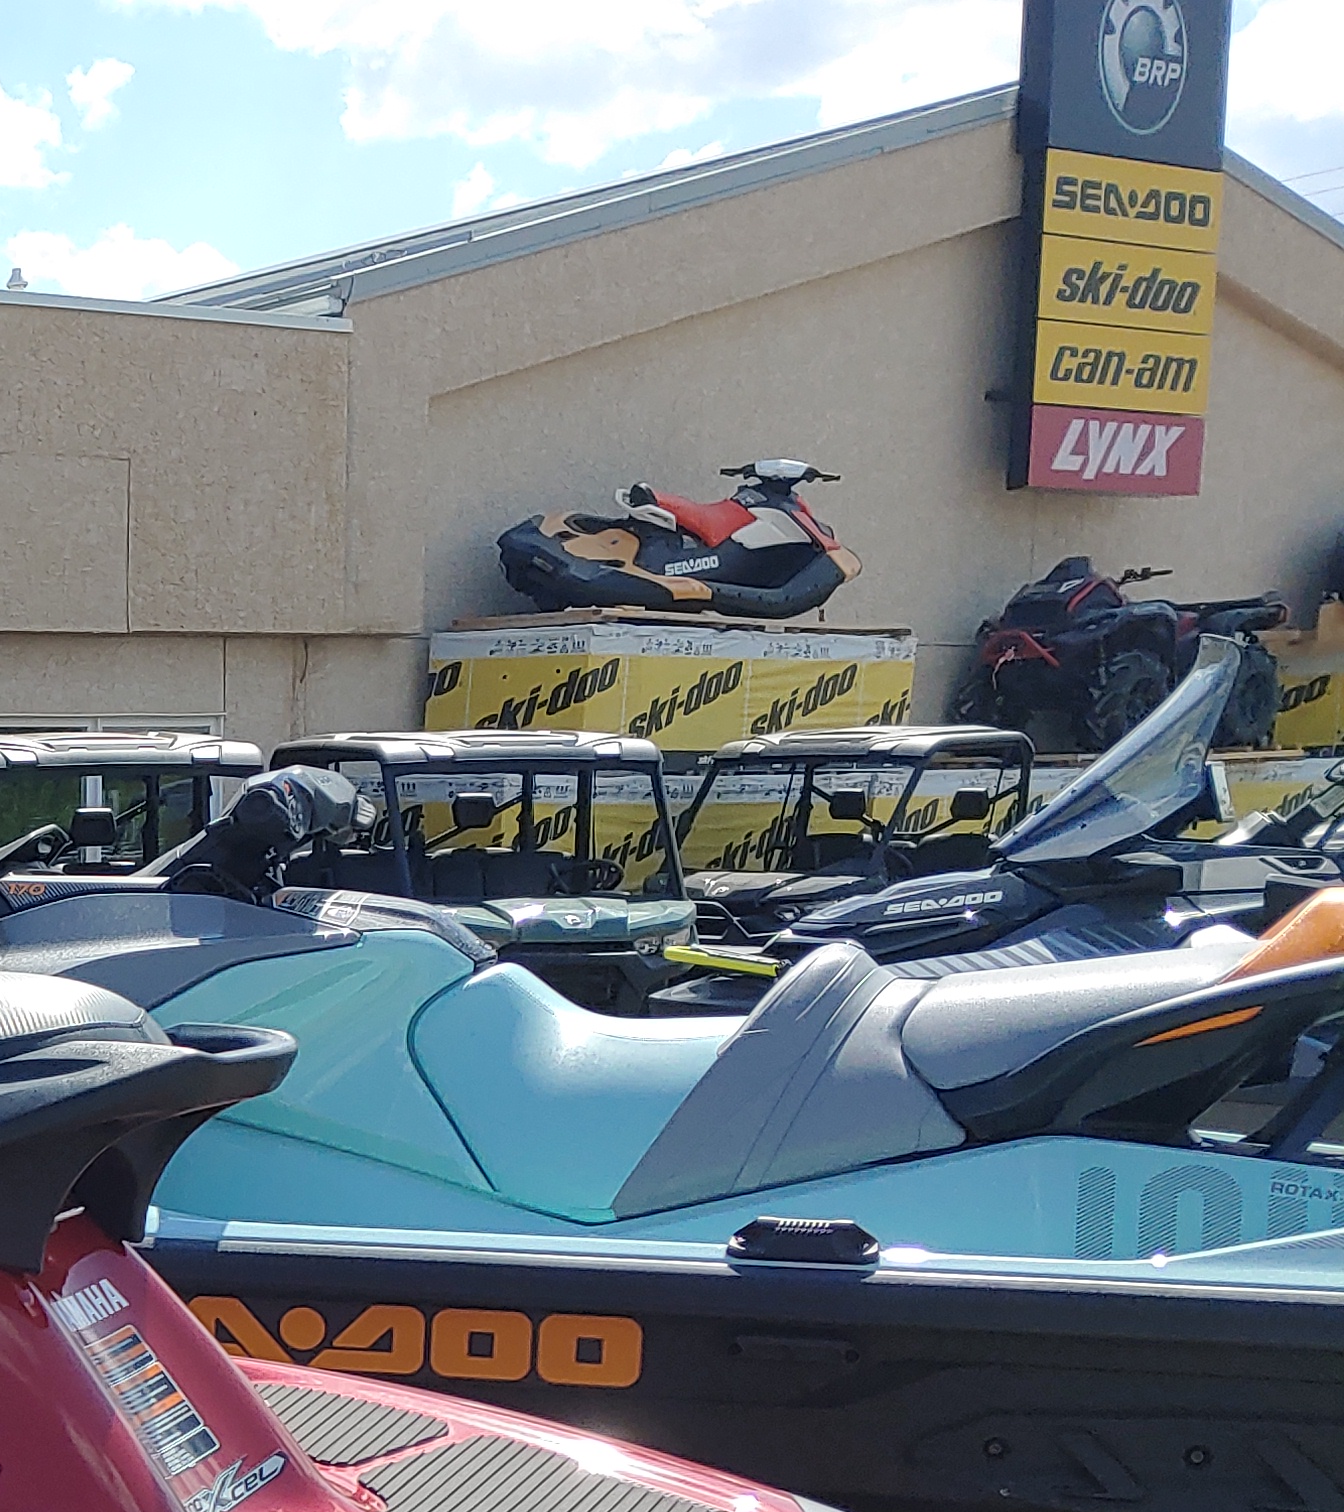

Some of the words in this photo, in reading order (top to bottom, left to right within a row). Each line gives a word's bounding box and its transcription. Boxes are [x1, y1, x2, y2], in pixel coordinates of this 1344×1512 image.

[1134, 57, 1181, 87] BRP
[1056, 260, 1200, 315] ski-doo
[1049, 345, 1198, 393] can-am
[1051, 419, 1186, 480] LYNX
[628, 660, 744, 738] ski-doo
[750, 662, 858, 735] ski-doo
[1270, 1181, 1340, 1202] ROTAX
